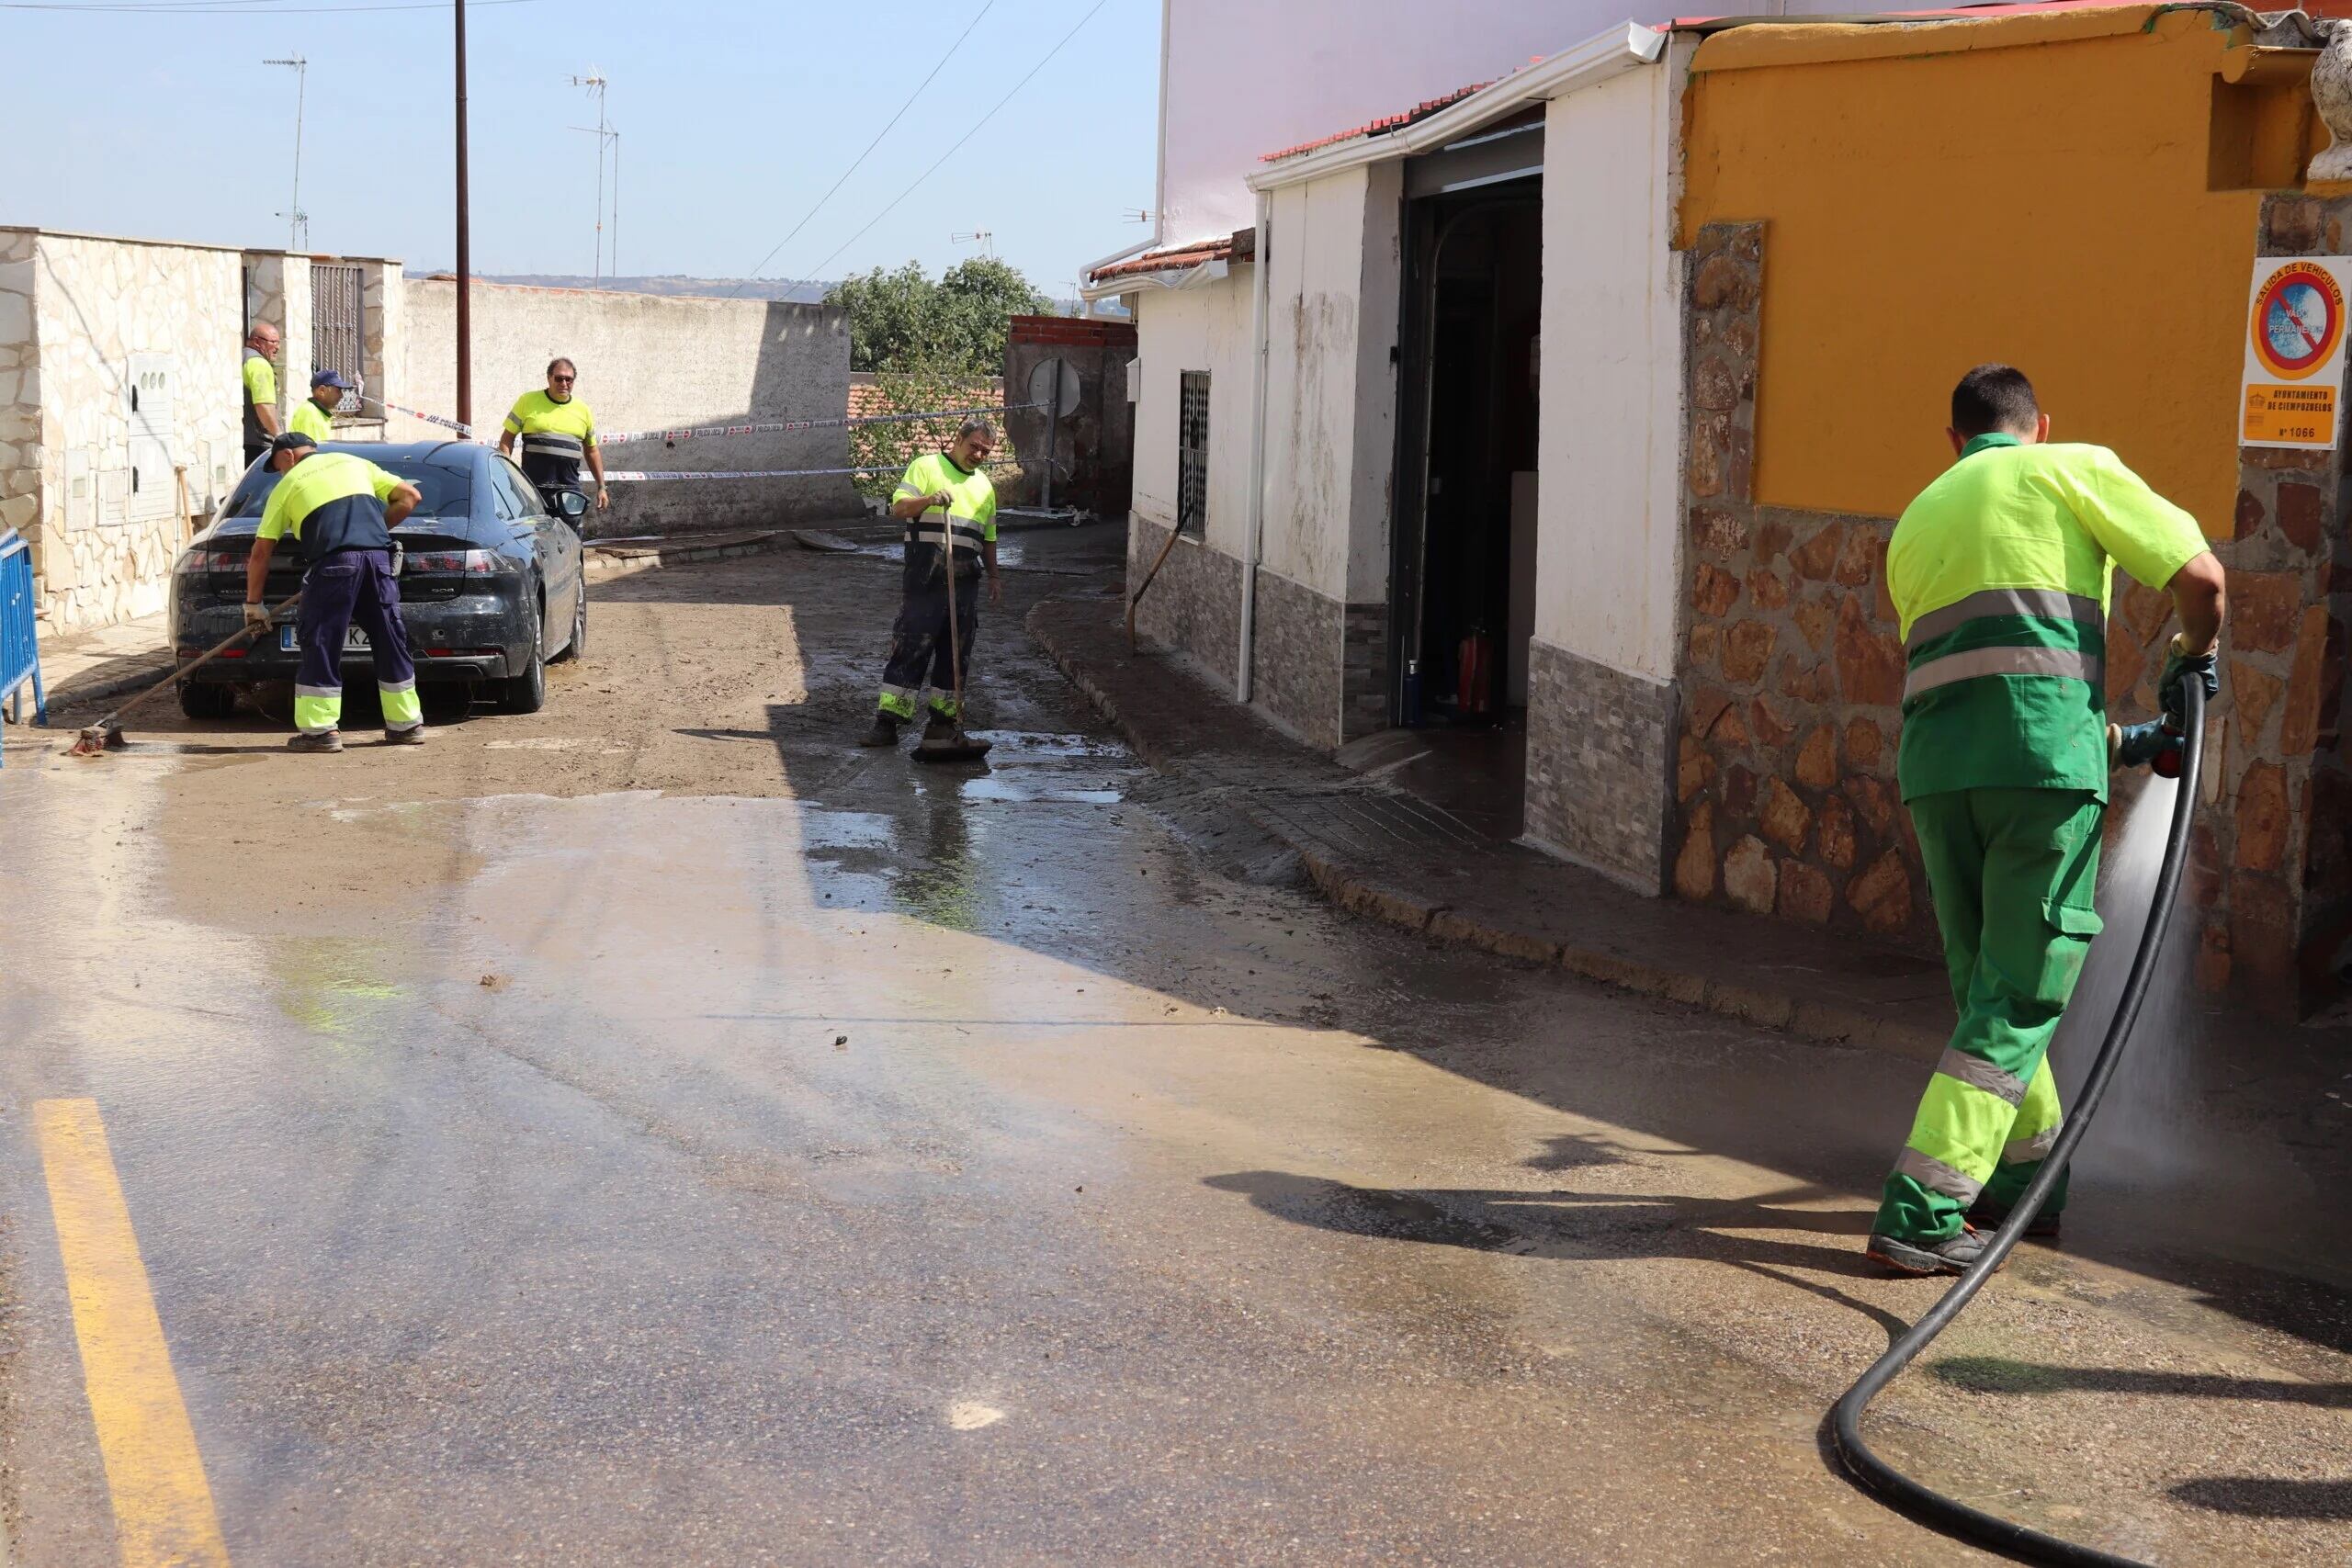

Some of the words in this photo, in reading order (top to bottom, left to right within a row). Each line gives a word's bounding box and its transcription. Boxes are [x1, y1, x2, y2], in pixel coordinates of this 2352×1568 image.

[2256, 270, 2284, 305] SALIDA
[2285, 263, 2298, 274] DE
[2301, 263, 2344, 306] VEHICULOS
[2273, 390, 2328, 400] AYUNTAMIENTO
[2267, 401, 2277, 411] DE
[2278, 401, 2332, 412] CIEMPOZUELOS
[2290, 427, 2315, 437] 1066
